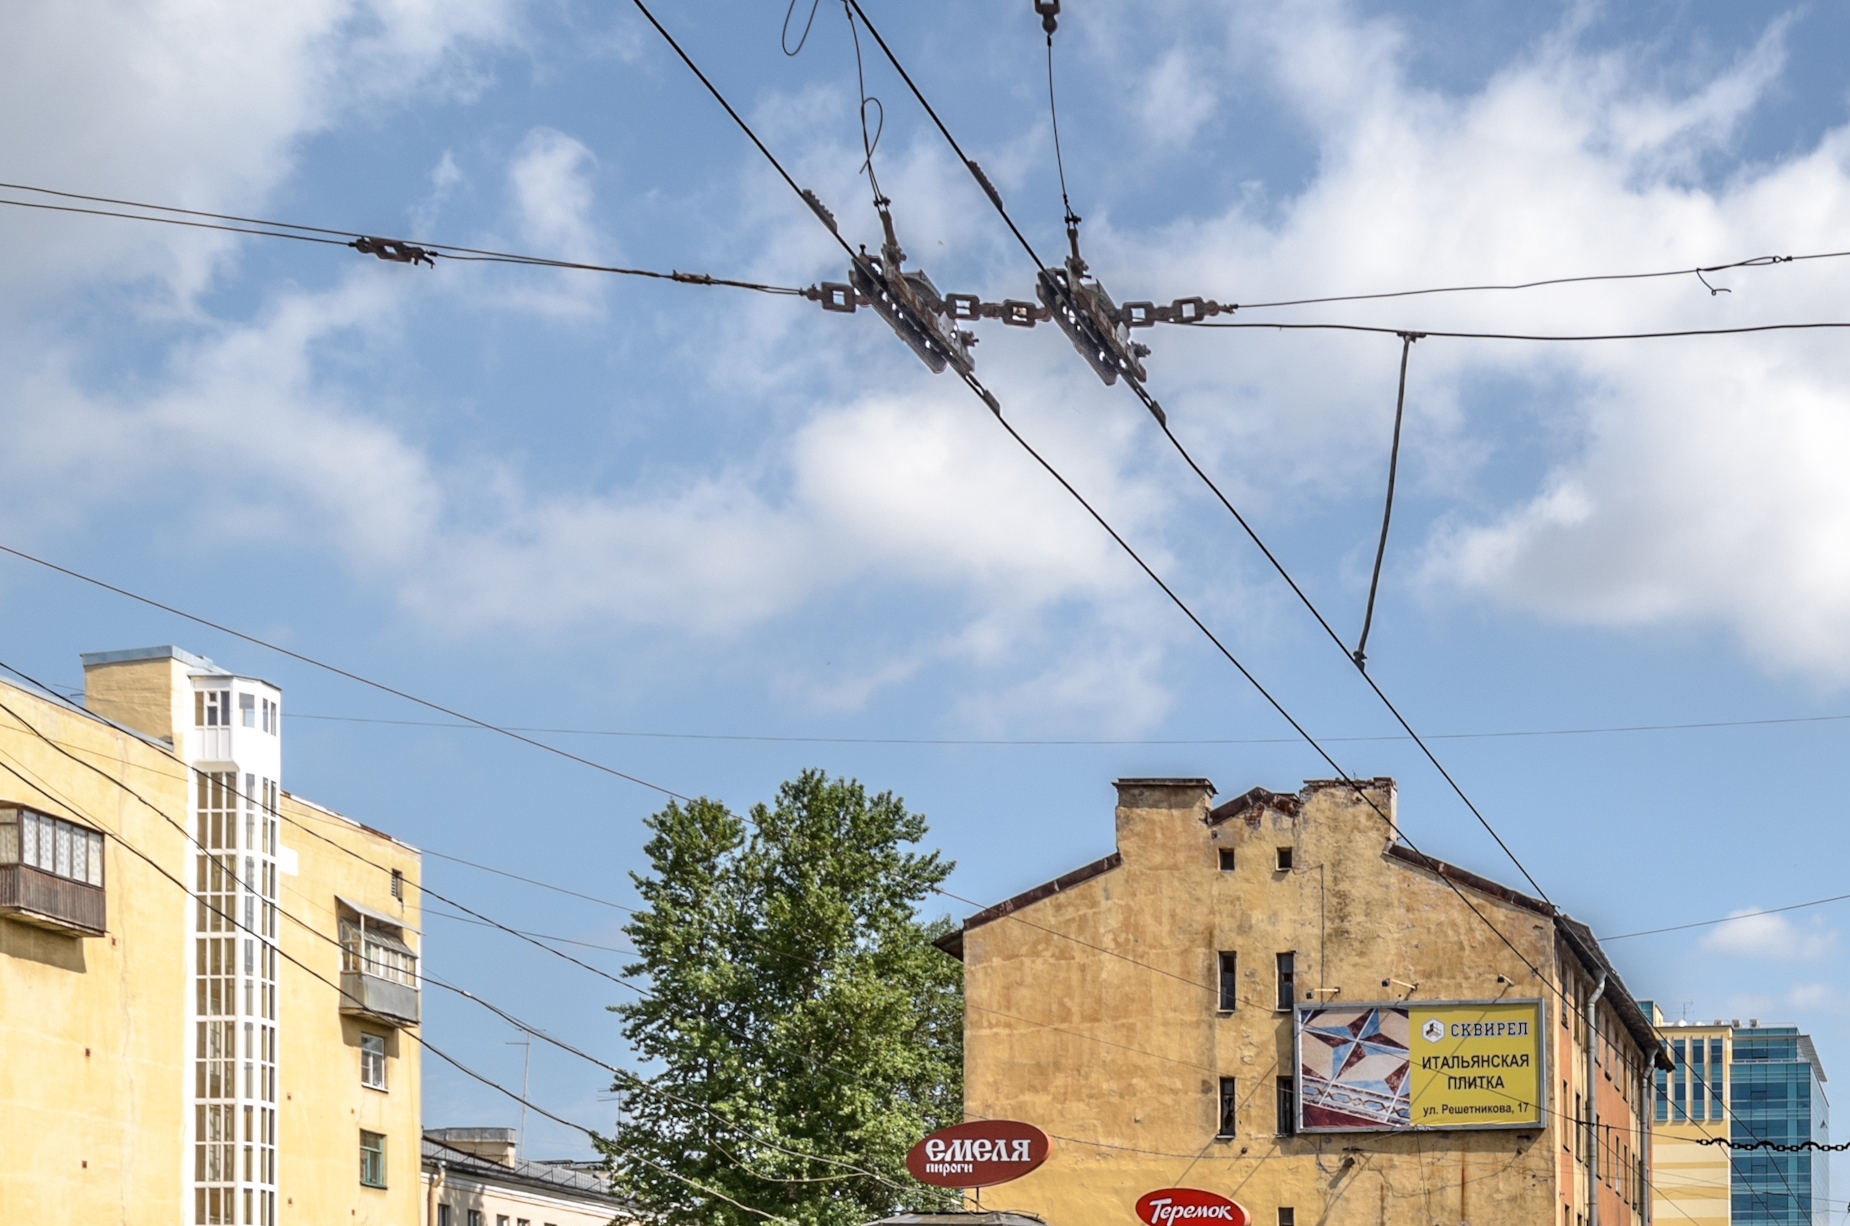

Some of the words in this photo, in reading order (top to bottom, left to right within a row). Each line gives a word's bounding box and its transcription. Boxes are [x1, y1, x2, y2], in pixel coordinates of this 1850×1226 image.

[1451, 1022, 1528, 1037] СКВИРЕЛ
[1422, 1054, 1529, 1069] ИТАЛЬЯНСКАЯ
[1447, 1075, 1505, 1090] ПЛИТКА
[1423, 1106, 1438, 1117] ул.
[1441, 1104, 1515, 1115] Решетникова,
[1517, 1102, 1529, 1112] 17
[926, 1163, 973, 1176] пироги
[1149, 1198, 1233, 1226] Теремок
